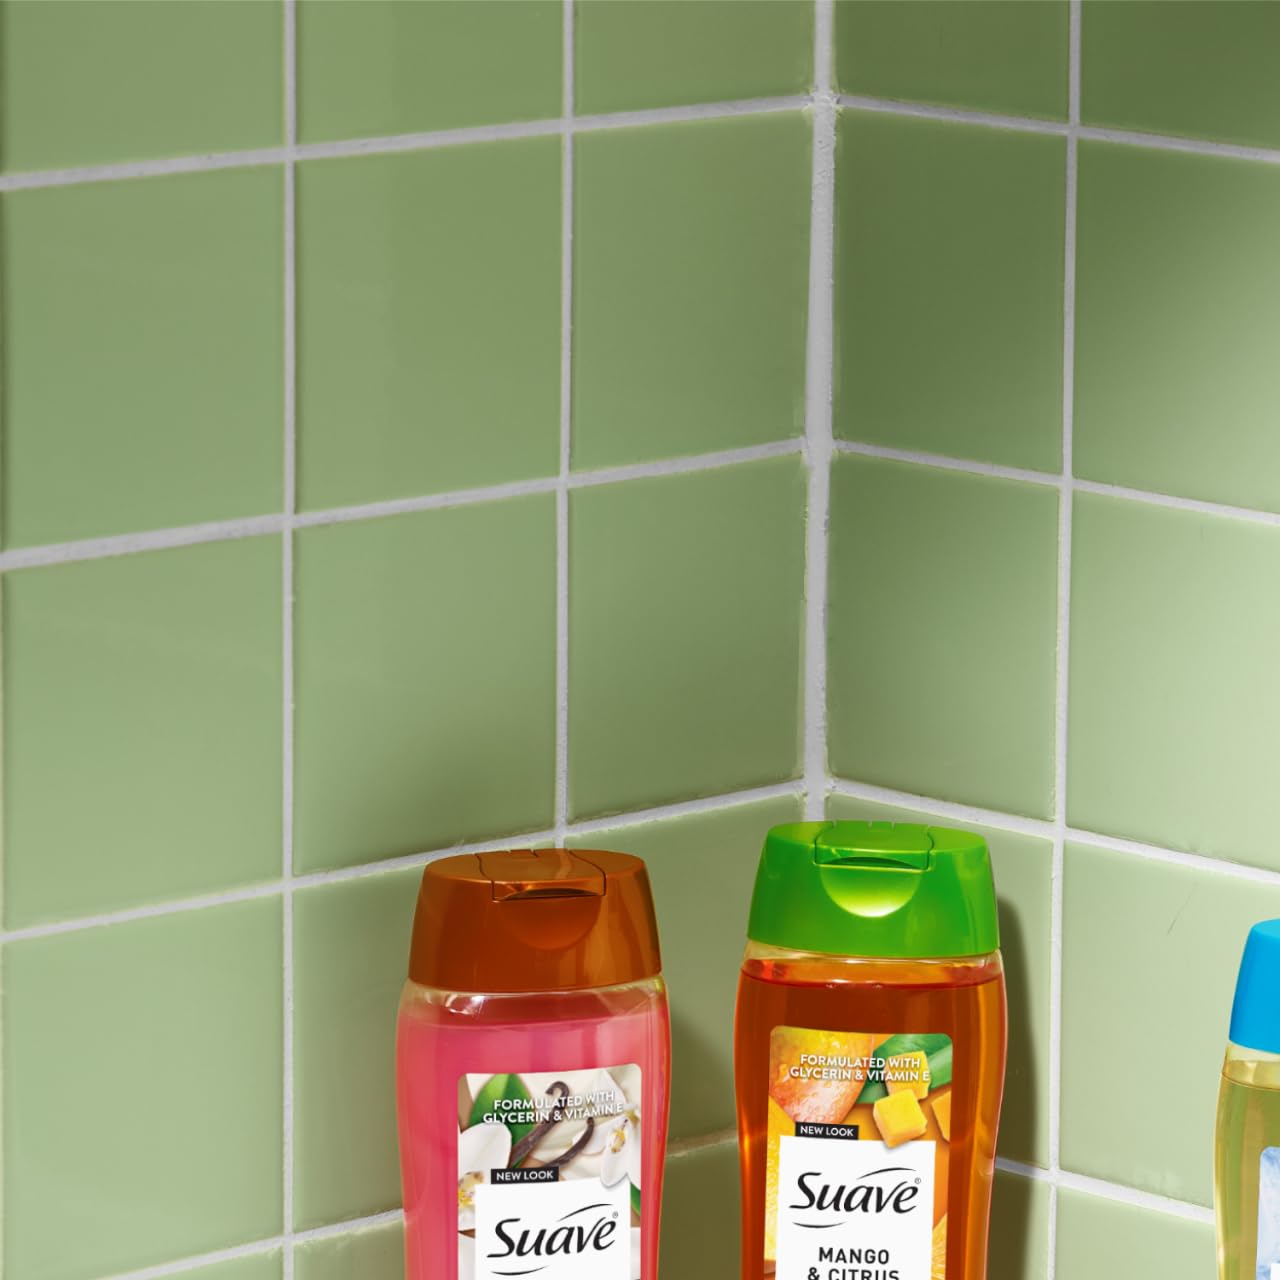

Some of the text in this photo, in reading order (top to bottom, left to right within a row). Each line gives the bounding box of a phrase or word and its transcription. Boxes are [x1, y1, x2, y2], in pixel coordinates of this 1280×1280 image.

[801, 1055, 920, 1068] FORMULATED WITH
[800, 1126, 853, 1136] NEW LOOK
[496, 1171, 553, 1181] NEW LOOK
[789, 1172, 919, 1214] Suave
[486, 1216, 616, 1258] Suave
[819, 1247, 889, 1264] MANGO
